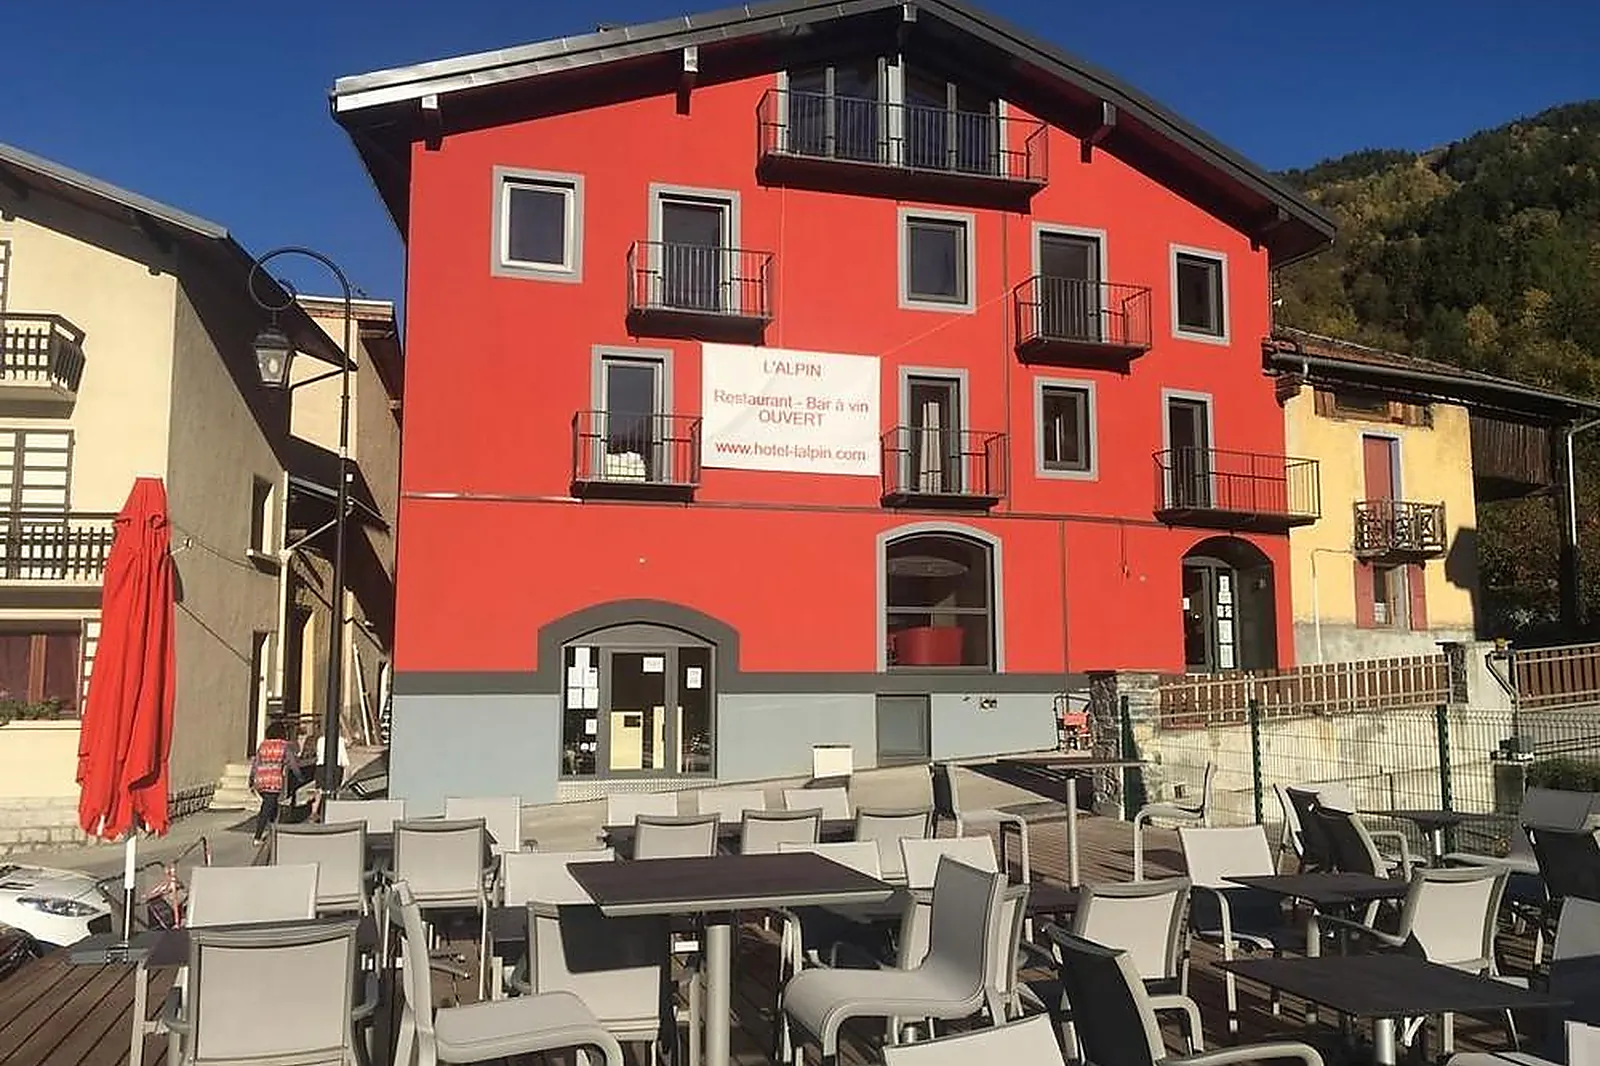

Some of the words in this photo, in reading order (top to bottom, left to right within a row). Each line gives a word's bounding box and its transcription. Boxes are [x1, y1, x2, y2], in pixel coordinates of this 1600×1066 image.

[763, 359, 822, 378] L'ALPIN
[714, 389, 793, 409] Restaurant
[806, 396, 831, 411] Bar
[848, 401, 869, 413] vin
[758, 409, 825, 427] OUVERT
[715, 440, 867, 462] www.hotel-lalpin.com
